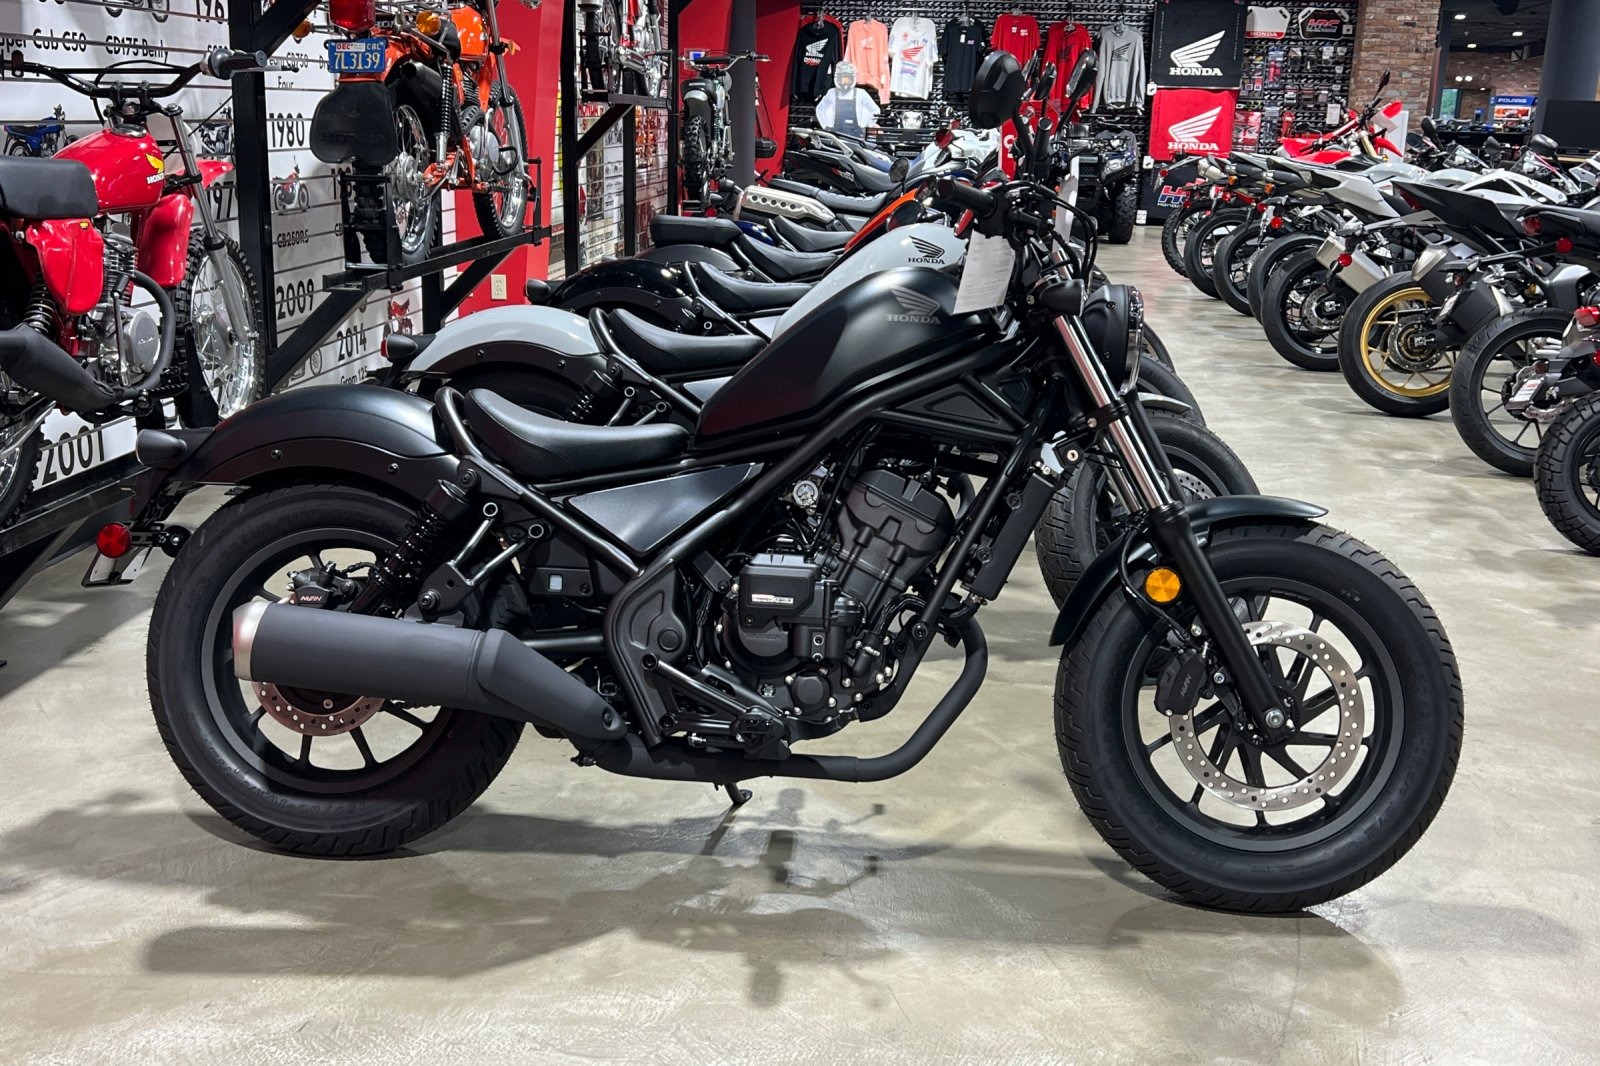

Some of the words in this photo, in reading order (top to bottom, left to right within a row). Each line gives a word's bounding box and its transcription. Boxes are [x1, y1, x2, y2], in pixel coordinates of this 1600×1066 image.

[62, 31, 87, 52] C50
[333, 52, 380, 69] 7L3139
[1169, 67, 1223, 76] HONDA
[269, 112, 305, 148] 1980
[1167, 141, 1219, 151] HONDA
[907, 257, 946, 265] HONDA
[276, 278, 315, 320] 2009
[886, 313, 942, 325] HONDA
[337, 323, 367, 362] 2014
[41, 425, 106, 485] 2001
